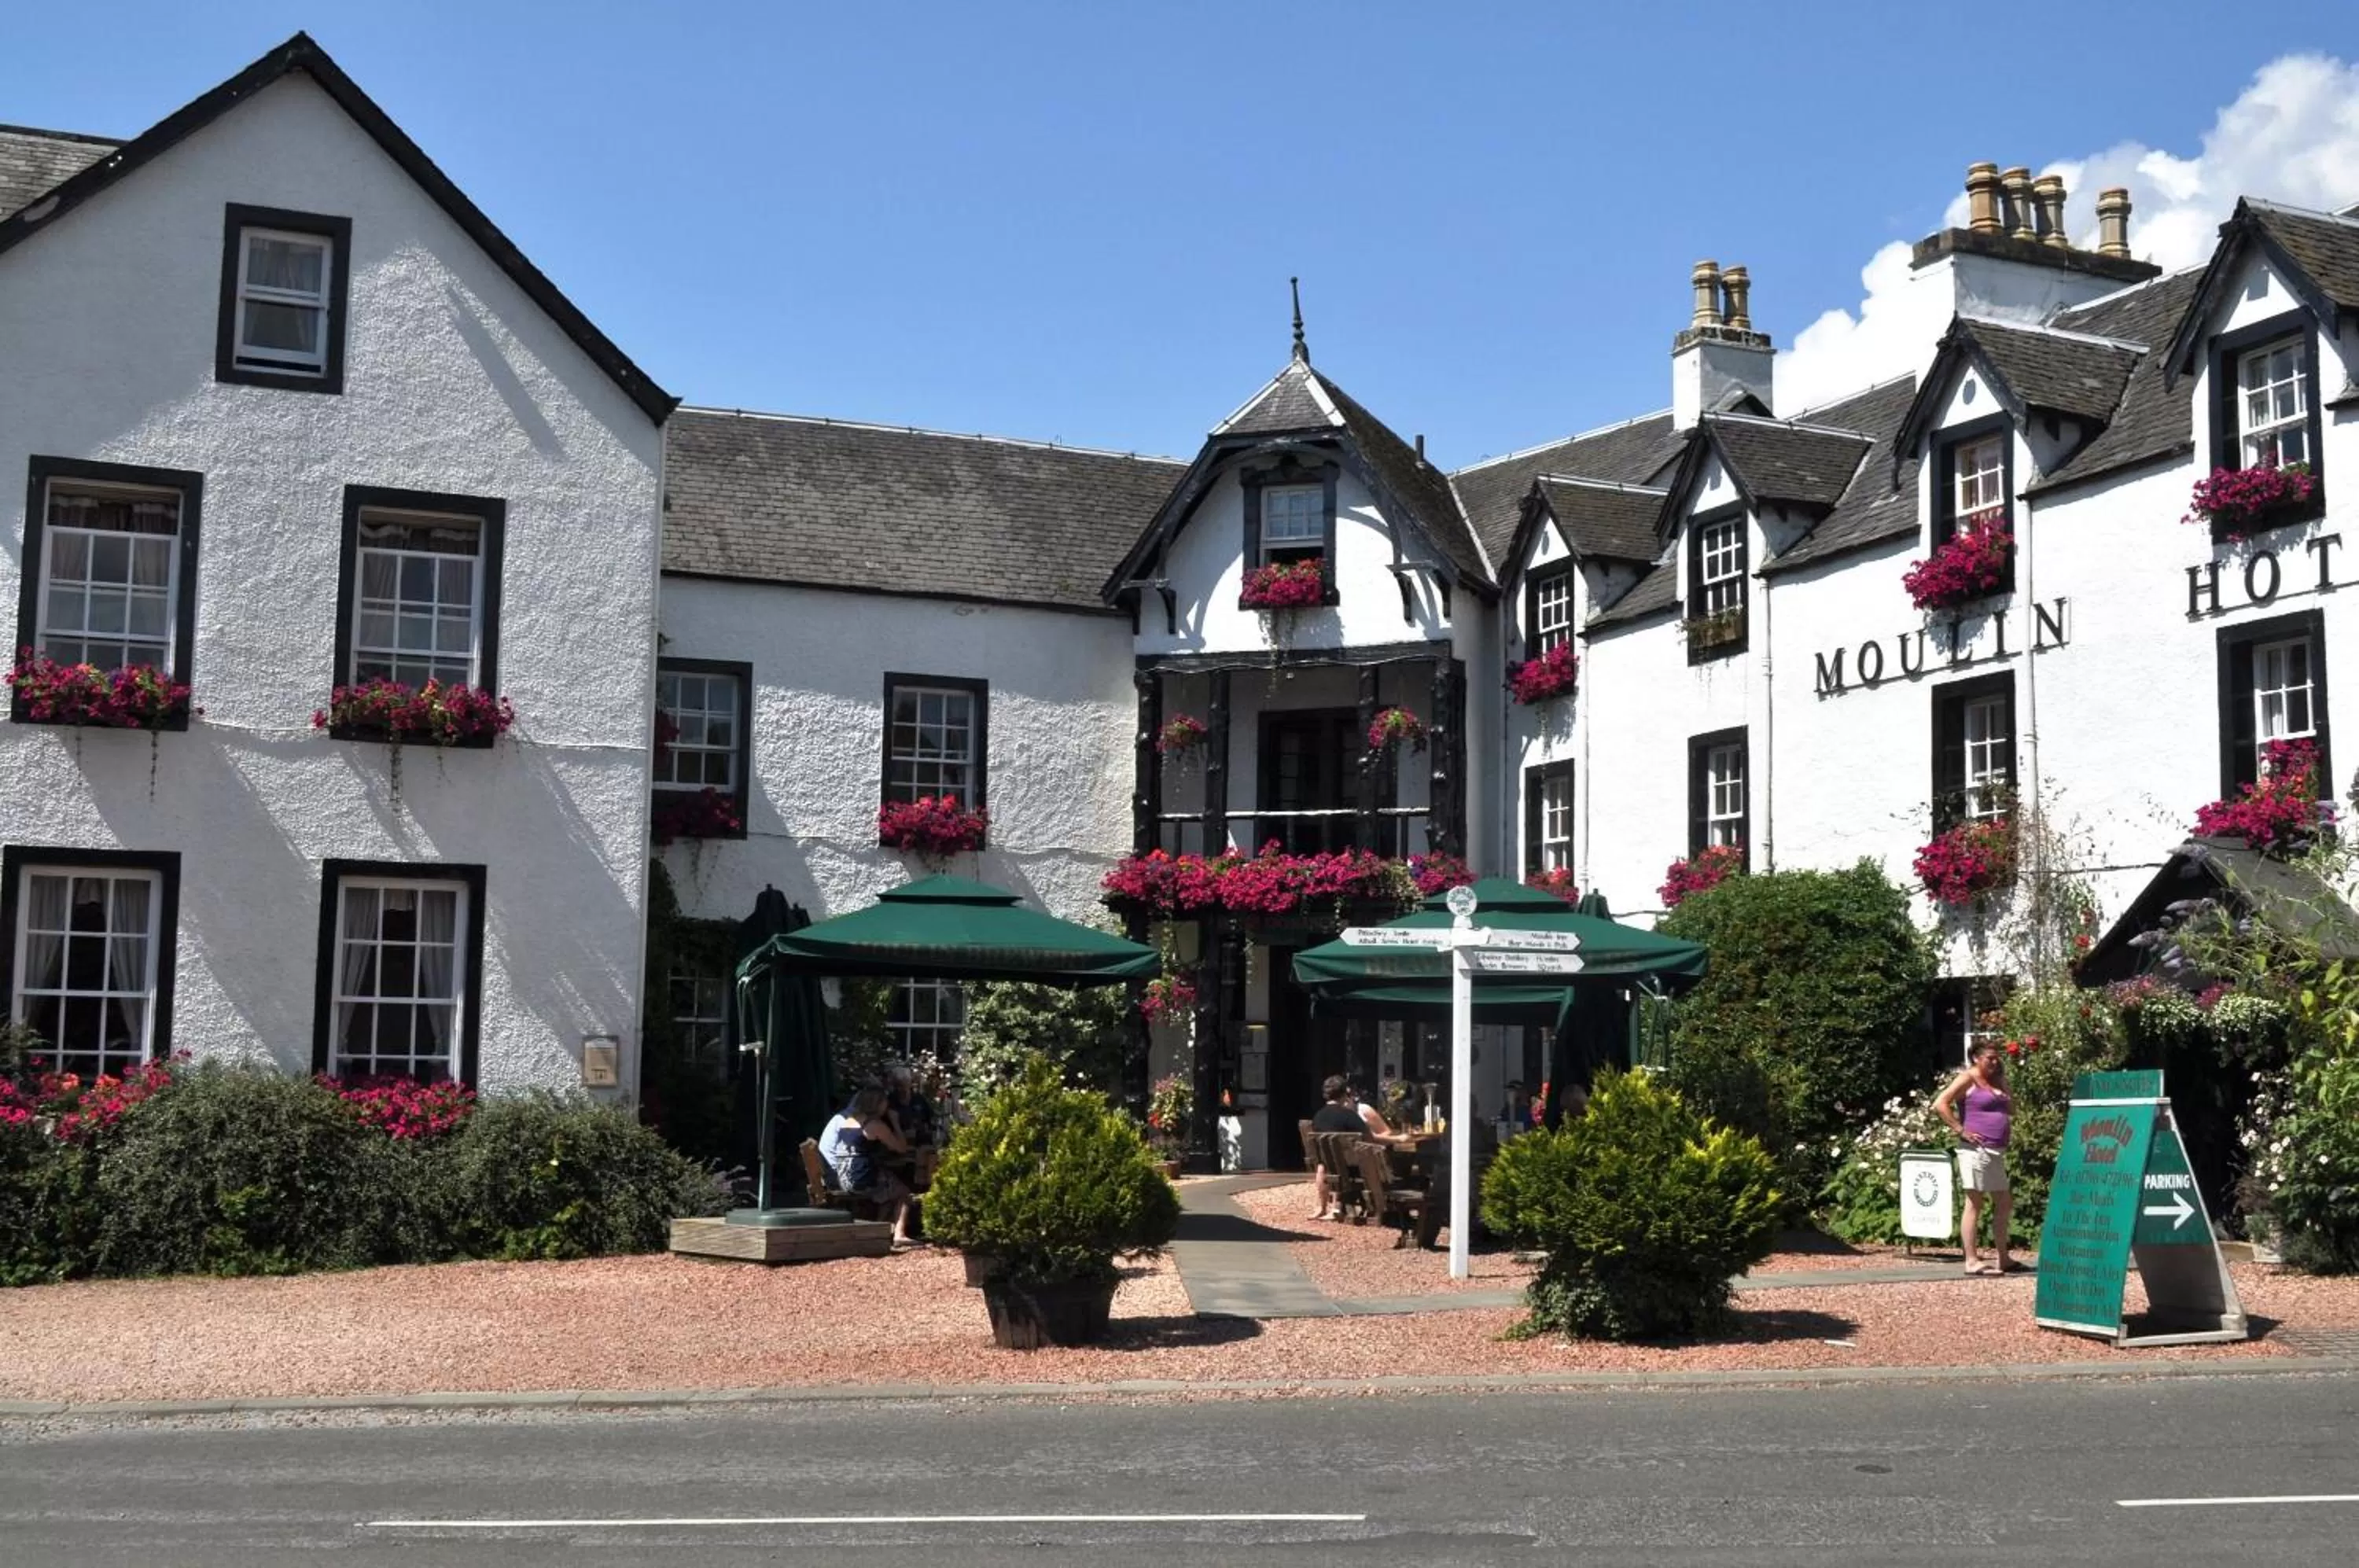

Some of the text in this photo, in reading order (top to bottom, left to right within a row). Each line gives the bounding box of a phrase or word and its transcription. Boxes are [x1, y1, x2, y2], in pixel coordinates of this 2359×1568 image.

[1814, 533, 2342, 695] MOULIN HOT
[2085, 1143, 2119, 1164] Hotel
[2144, 1174, 2191, 1190] PARKING
